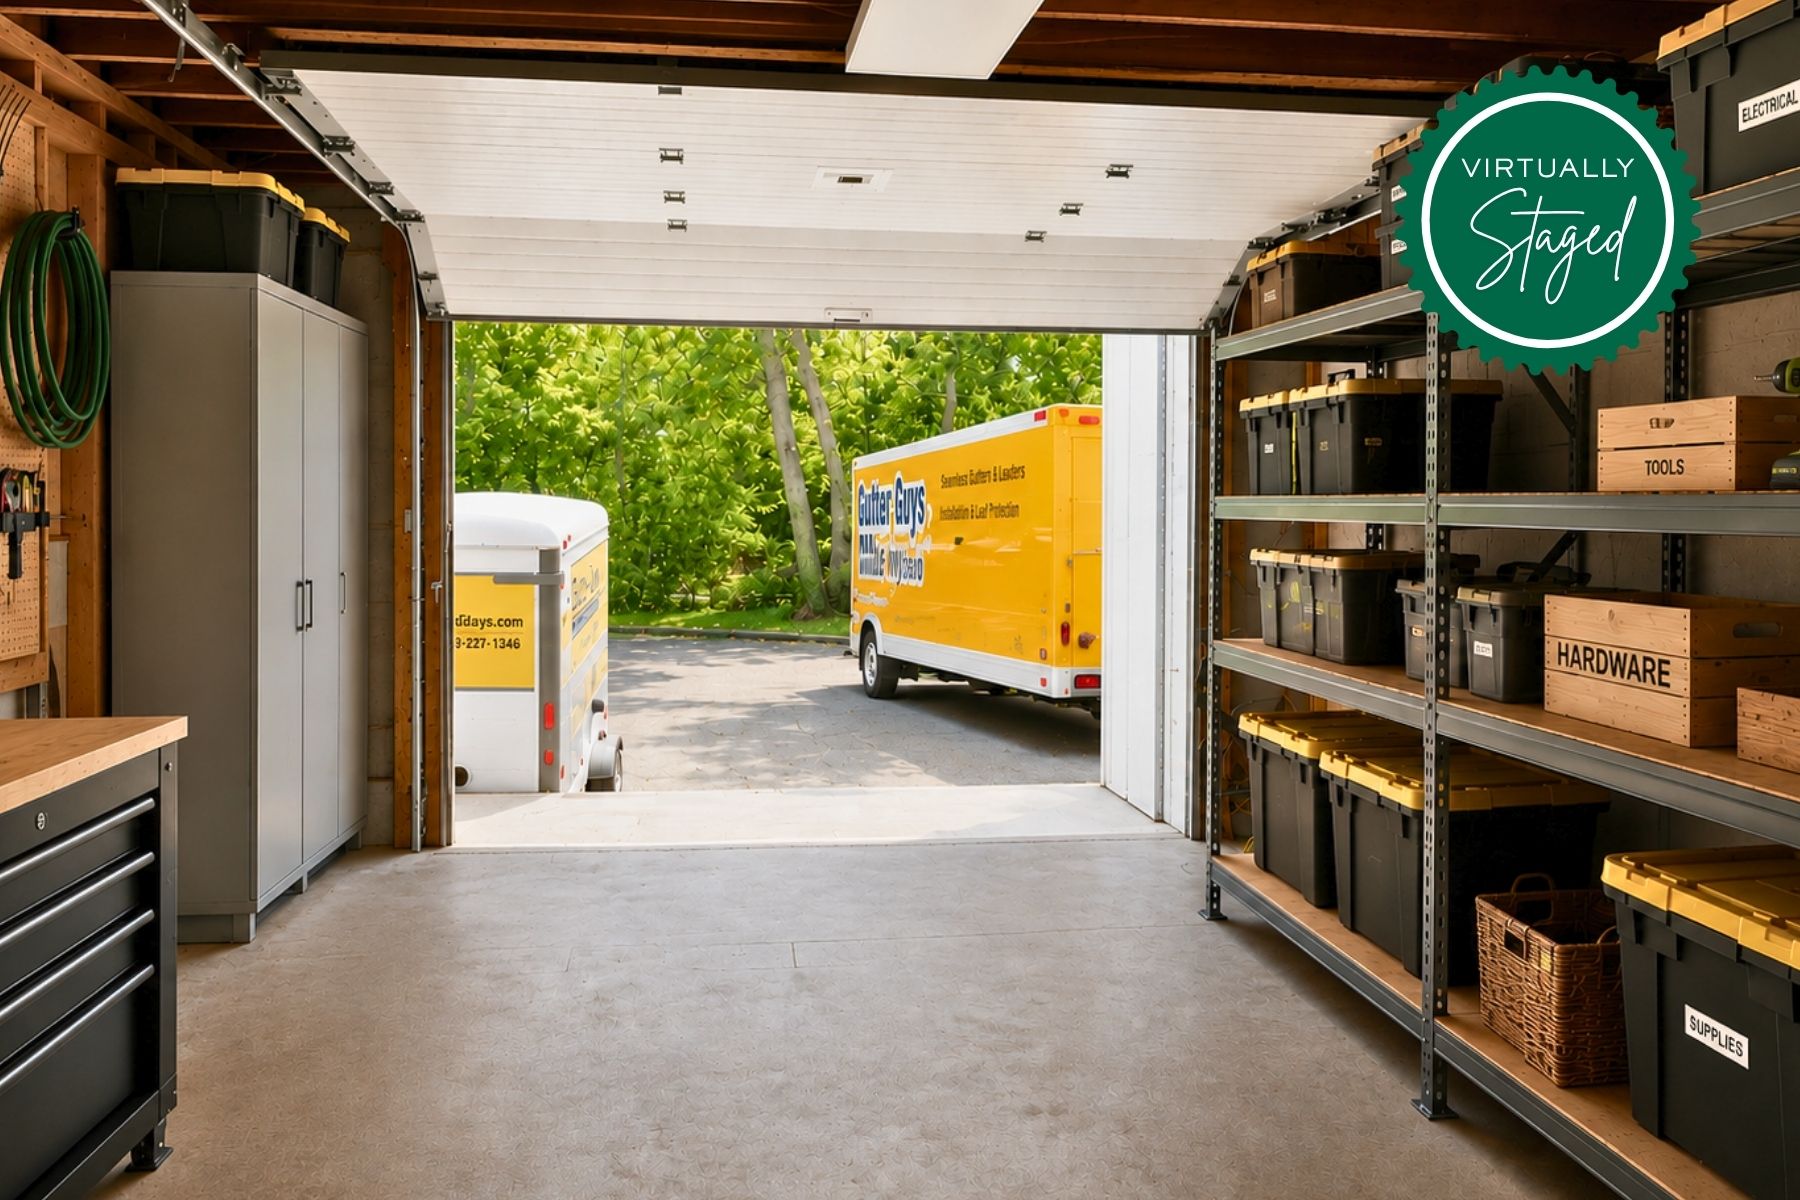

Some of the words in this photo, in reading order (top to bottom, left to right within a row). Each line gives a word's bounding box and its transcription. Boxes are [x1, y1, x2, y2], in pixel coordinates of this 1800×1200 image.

[1742, 89, 1799, 123] ELECTRICAL
[1644, 458, 1685, 476] TOOLS
[858, 483, 892, 527] Gutter
[895, 476, 925, 539] Guys
[1557, 641, 1671, 689] HARDWARE
[1689, 1014, 1744, 1057] SUPPLIES
